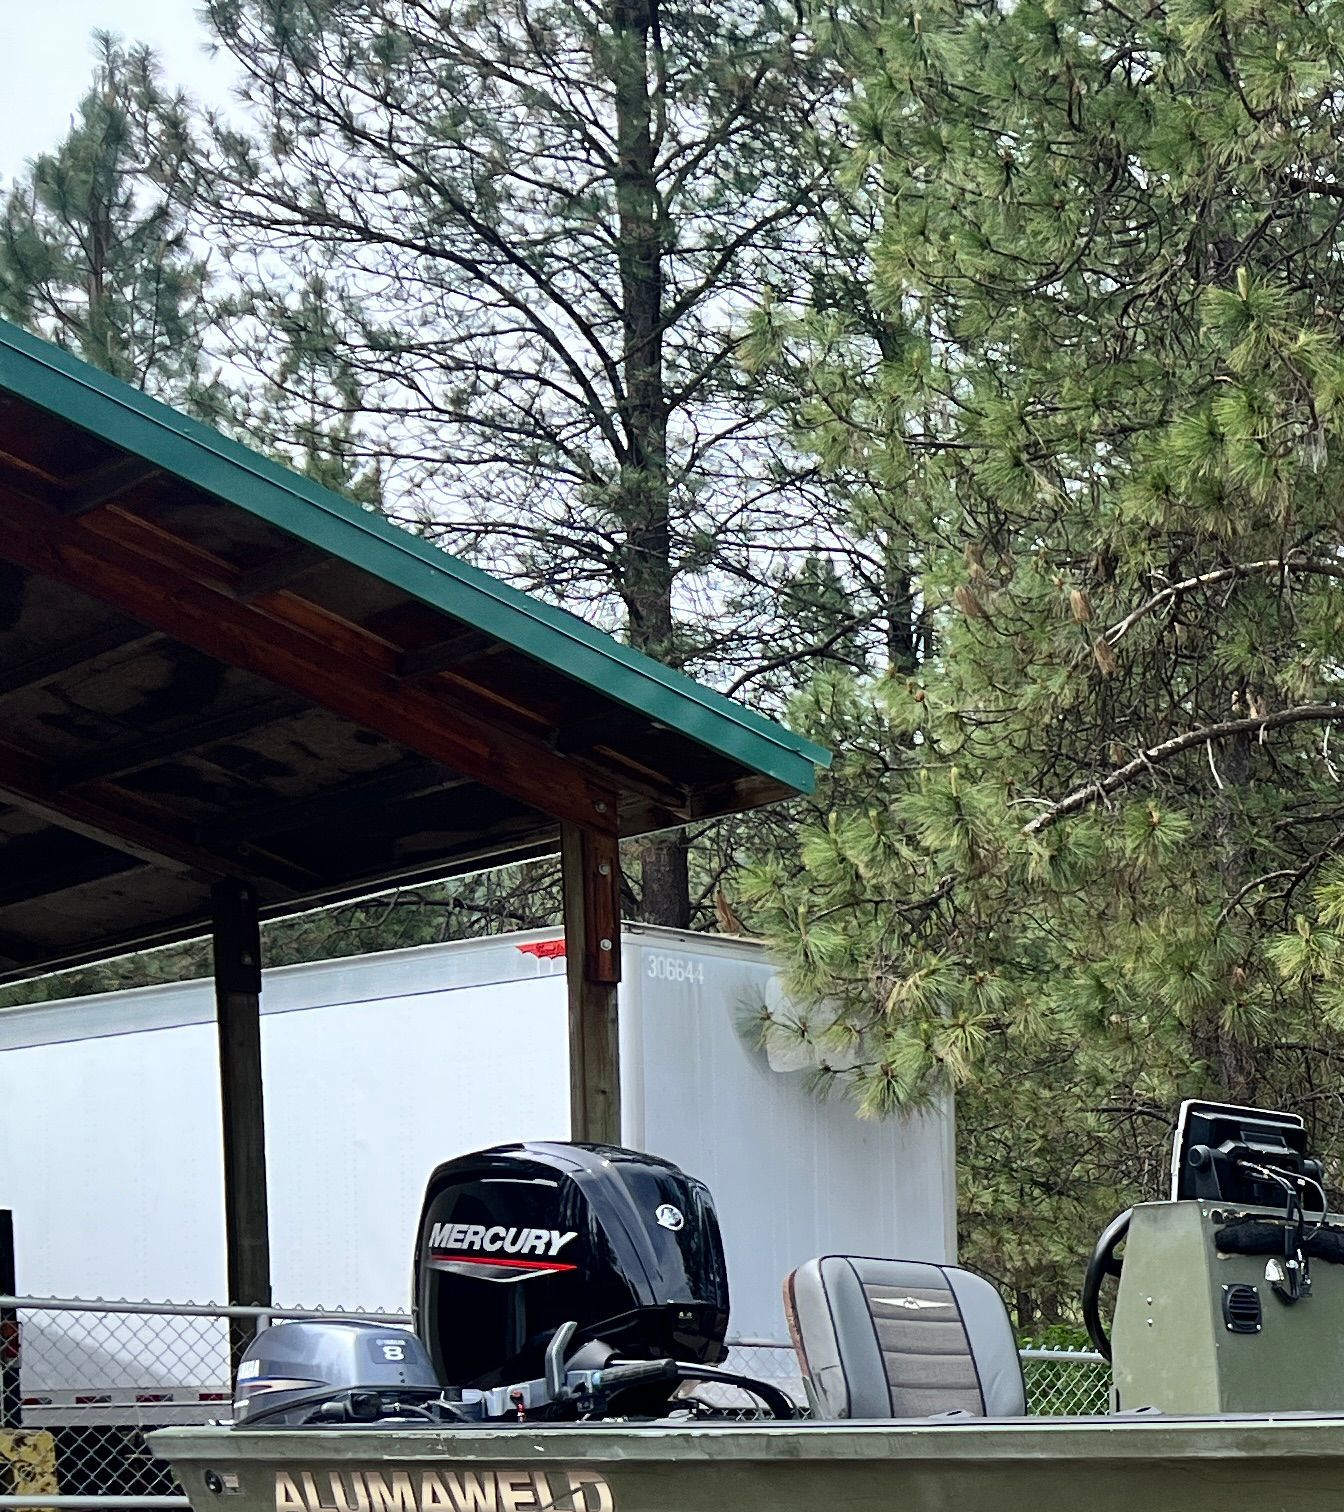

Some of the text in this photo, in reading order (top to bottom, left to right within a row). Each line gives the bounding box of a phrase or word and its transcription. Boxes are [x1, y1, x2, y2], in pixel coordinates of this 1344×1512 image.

[648, 955, 704, 985] 306644
[428, 1222, 578, 1256] MERCURY
[382, 1345, 405, 1361] 8
